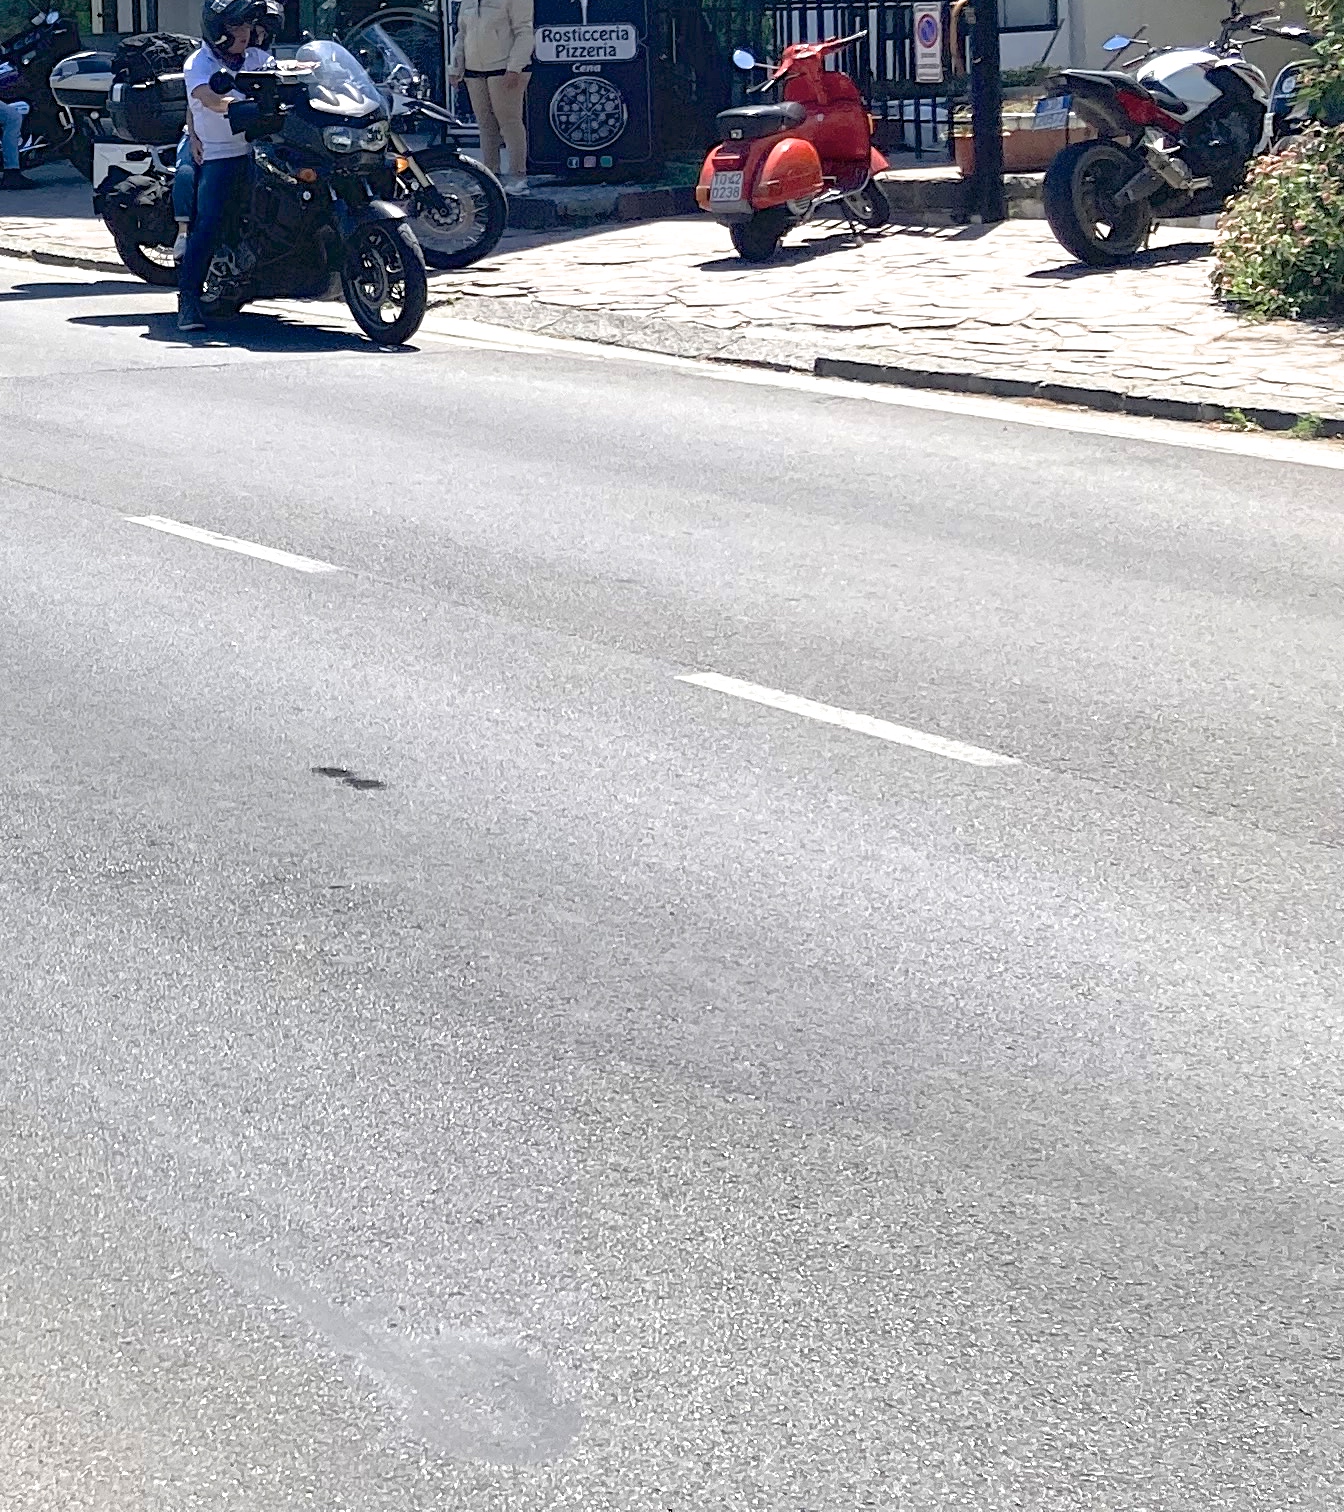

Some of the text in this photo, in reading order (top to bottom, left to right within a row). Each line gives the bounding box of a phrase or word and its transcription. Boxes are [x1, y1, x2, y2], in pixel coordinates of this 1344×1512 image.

[541, 25, 629, 43] Rosticceria
[555, 43, 617, 59] Pizzeria
[571, 63, 602, 73] Cena
